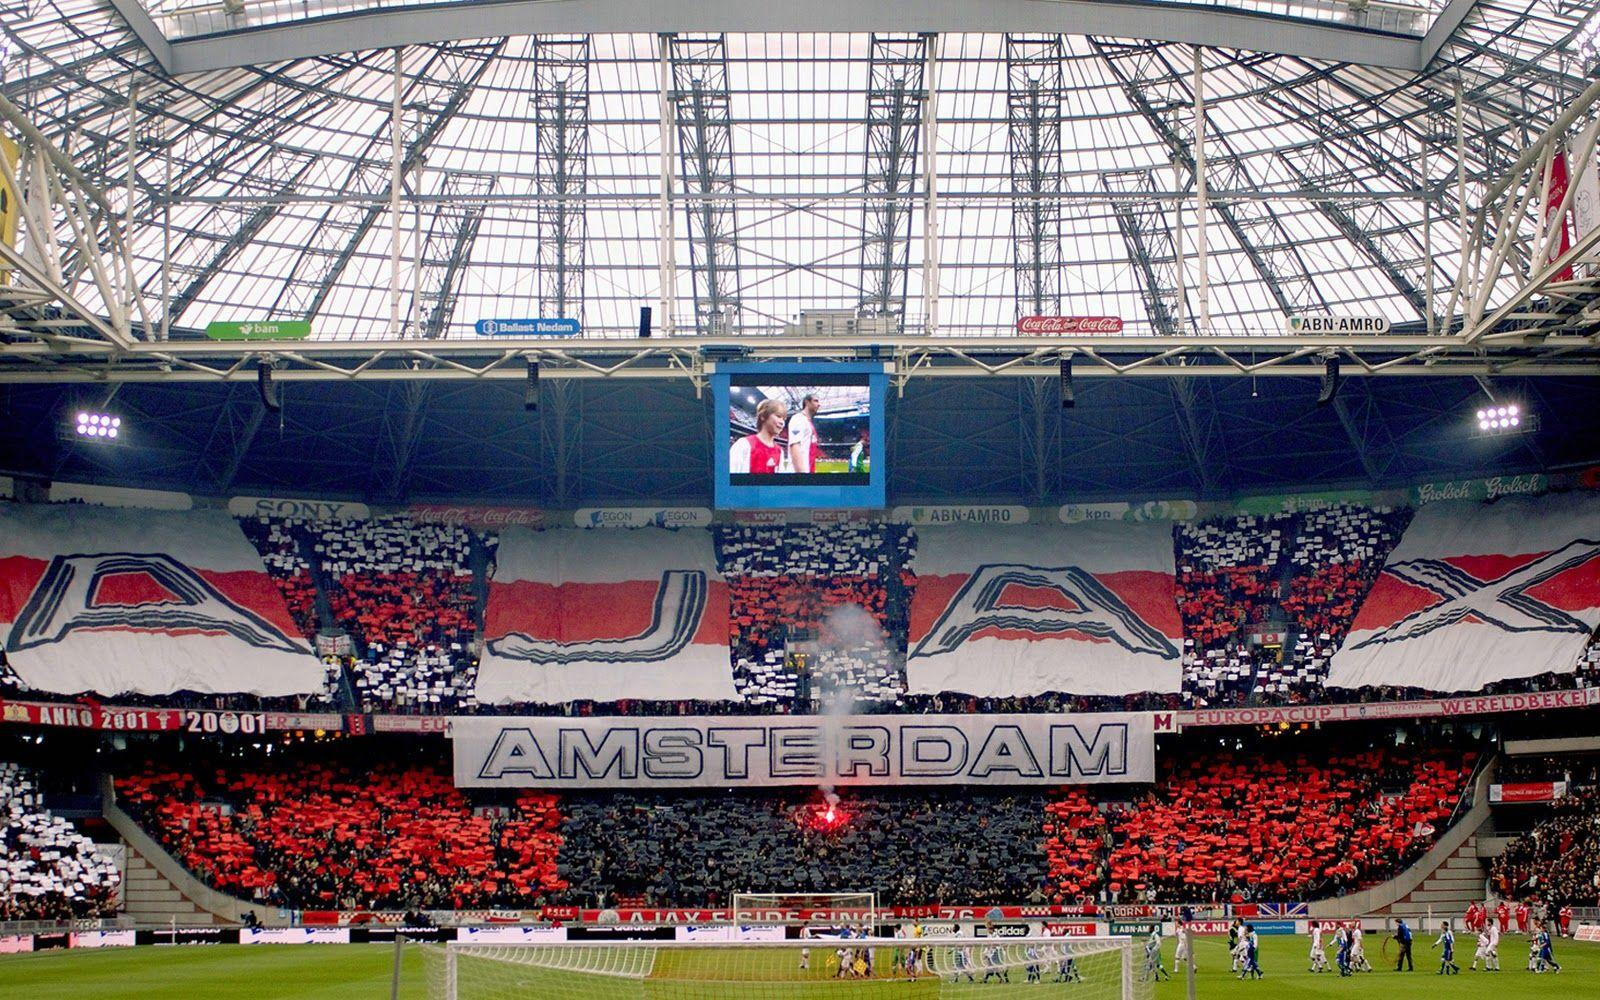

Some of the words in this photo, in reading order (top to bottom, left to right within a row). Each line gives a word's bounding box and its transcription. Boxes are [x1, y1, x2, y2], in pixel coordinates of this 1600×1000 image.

[255, 324, 279, 333] bam
[499, 323, 534, 332] Ballast
[537, 323, 573, 332] Nedam
[1418, 481, 1471, 505] Grolsch
[1485, 474, 1539, 498] Grolsch
[256, 500, 344, 521] SONY
[40, 706, 93, 727] ANNO
[101, 711, 149, 729] 2001
[1154, 713, 1171, 730] M
[1195, 707, 1331, 724] EUROPACUP
[477, 727, 1128, 779] AMSTERDAM
[630, 911, 701, 924] AJAX
